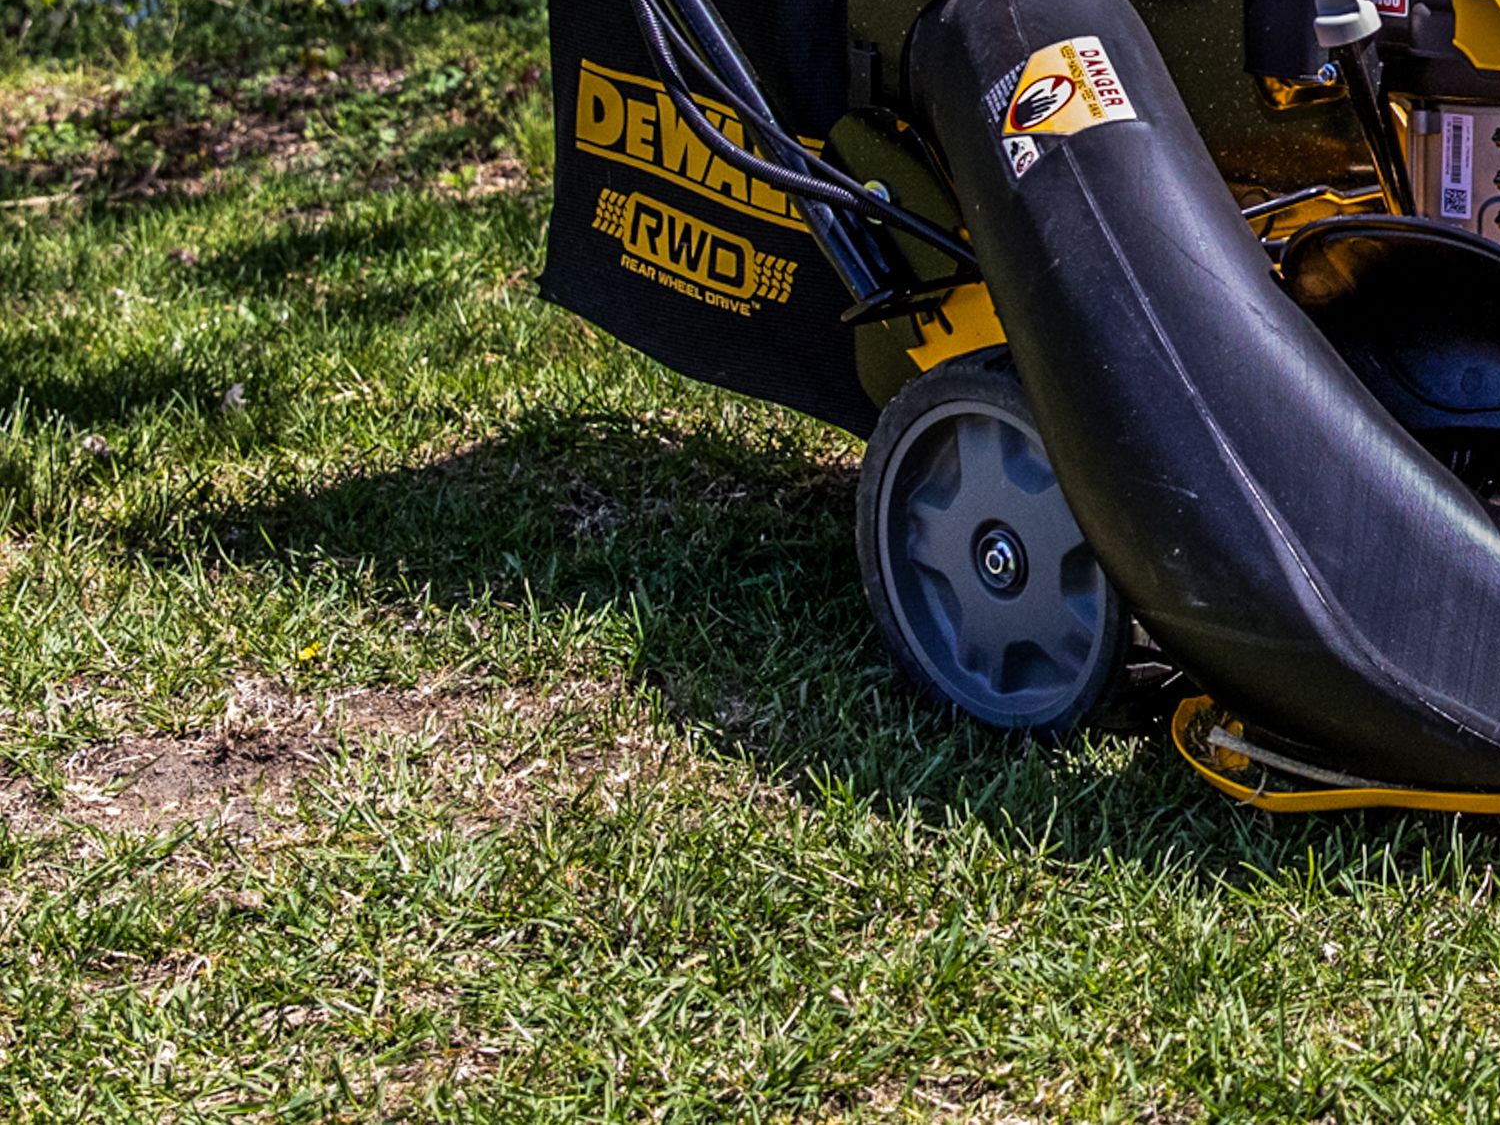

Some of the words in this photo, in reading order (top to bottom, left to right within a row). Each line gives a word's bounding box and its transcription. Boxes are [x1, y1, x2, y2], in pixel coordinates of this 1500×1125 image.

[1079, 49, 1124, 108] DANGER
[576, 67, 822, 221] DEWAL
[620, 254, 656, 281] REAR
[658, 270, 703, 301] WHEEL
[629, 200, 746, 289] RWD
